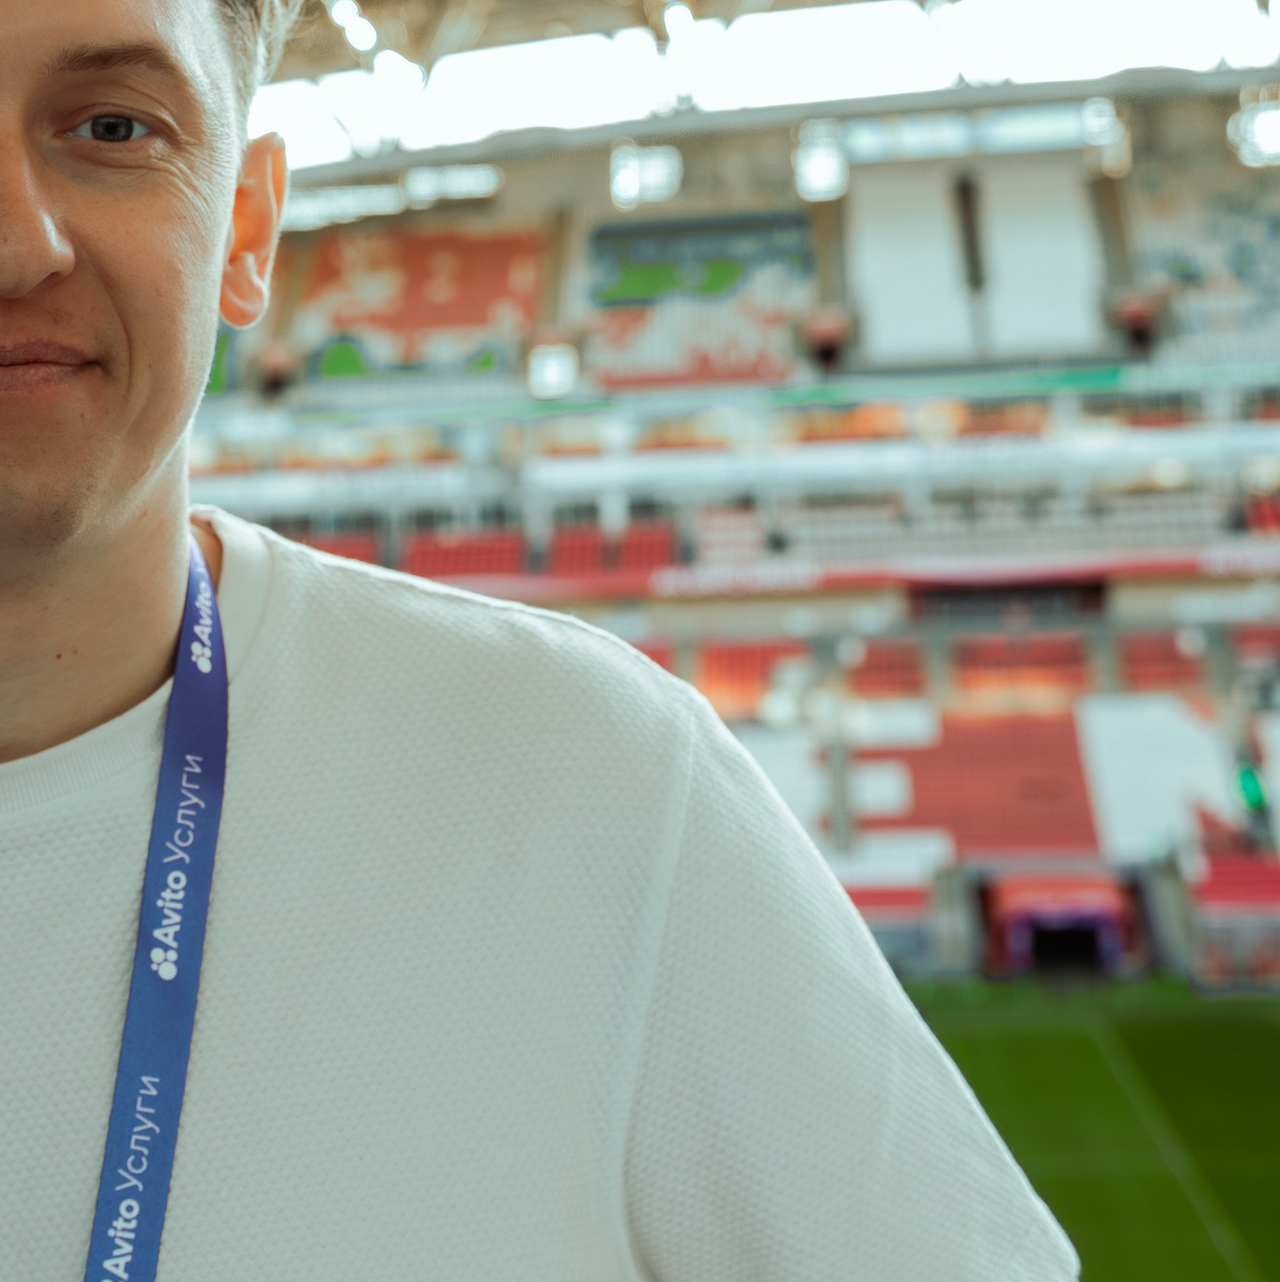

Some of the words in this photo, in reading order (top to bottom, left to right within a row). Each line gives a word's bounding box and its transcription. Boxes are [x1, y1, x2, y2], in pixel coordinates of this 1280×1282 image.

[193, 580, 213, 648] Avito
[162, 754, 206, 864] Услуги
[152, 870, 187, 949] Avito
[115, 1075, 160, 1192] Услуги
[102, 1198, 140, 1281] Avito
